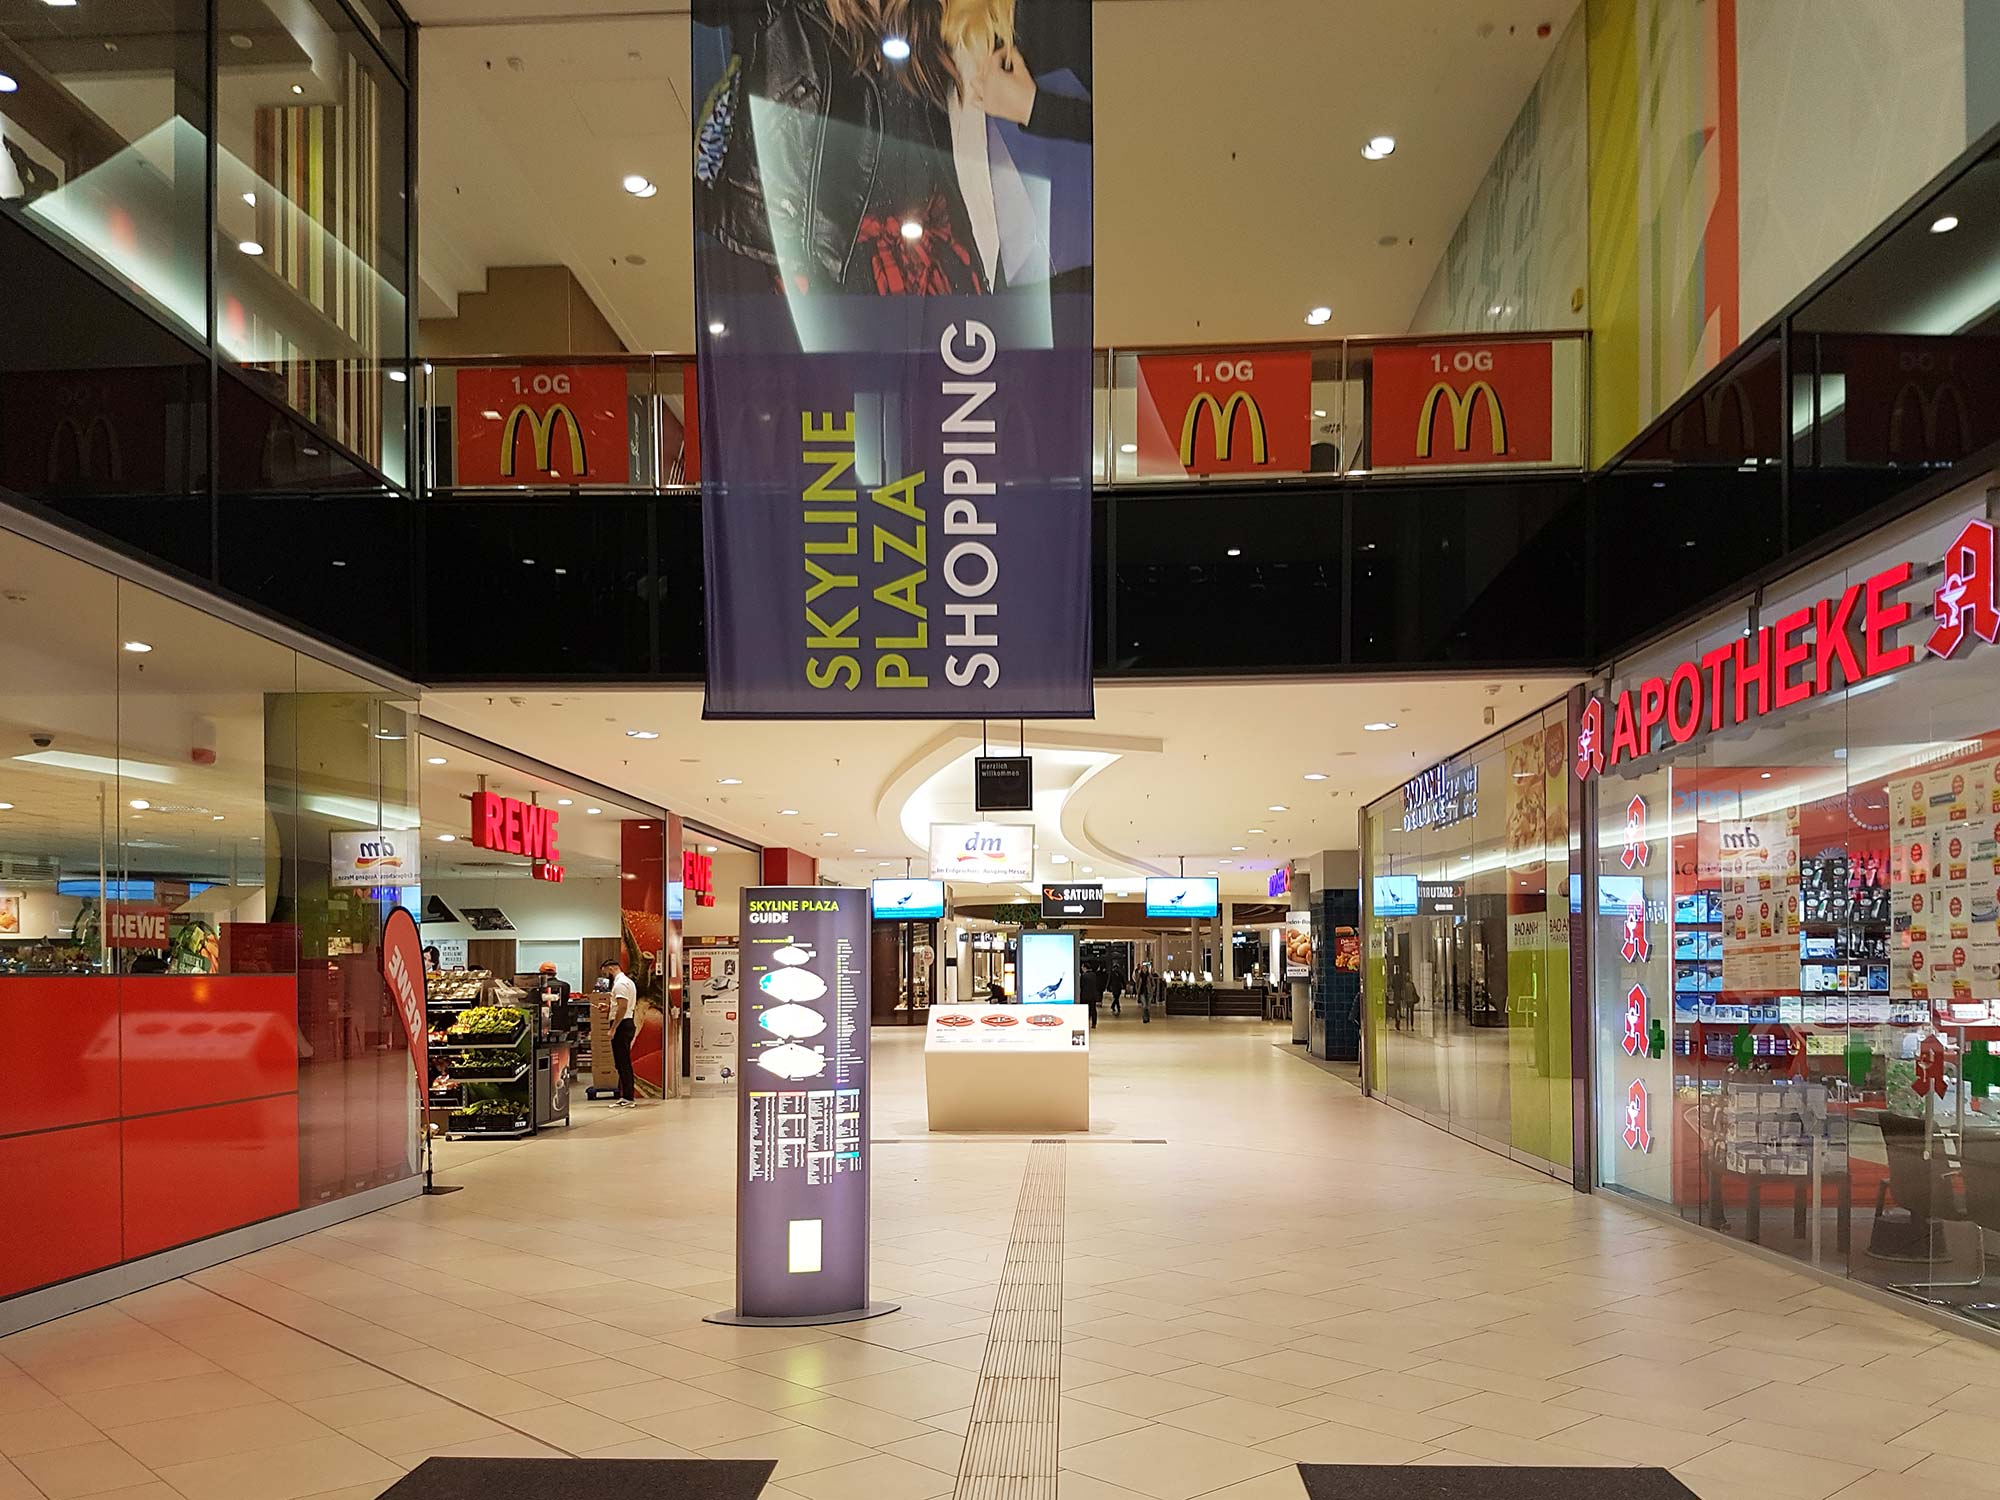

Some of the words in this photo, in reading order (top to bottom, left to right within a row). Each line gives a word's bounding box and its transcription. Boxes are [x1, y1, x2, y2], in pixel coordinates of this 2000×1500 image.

[941, 319, 1000, 689] SHOPPING
[802, 411, 861, 691] SKYLINE
[872, 470, 928, 689] PLAZA
[1610, 562, 1914, 766] APOTHEKE
[981, 762, 1008, 770] Herzlich
[484, 791, 560, 862] REWE
[965, 831, 1002, 851] dm
[543, 863, 566, 884] CITY
[1008, 867, 1027, 875] Messe
[1063, 888, 1103, 901] SATURN
[749, 900, 799, 911] SKYLINE
[801, 900, 840, 911] PLAZA
[112, 914, 166, 939] REWE
[749, 912, 789, 924] GUIDE
